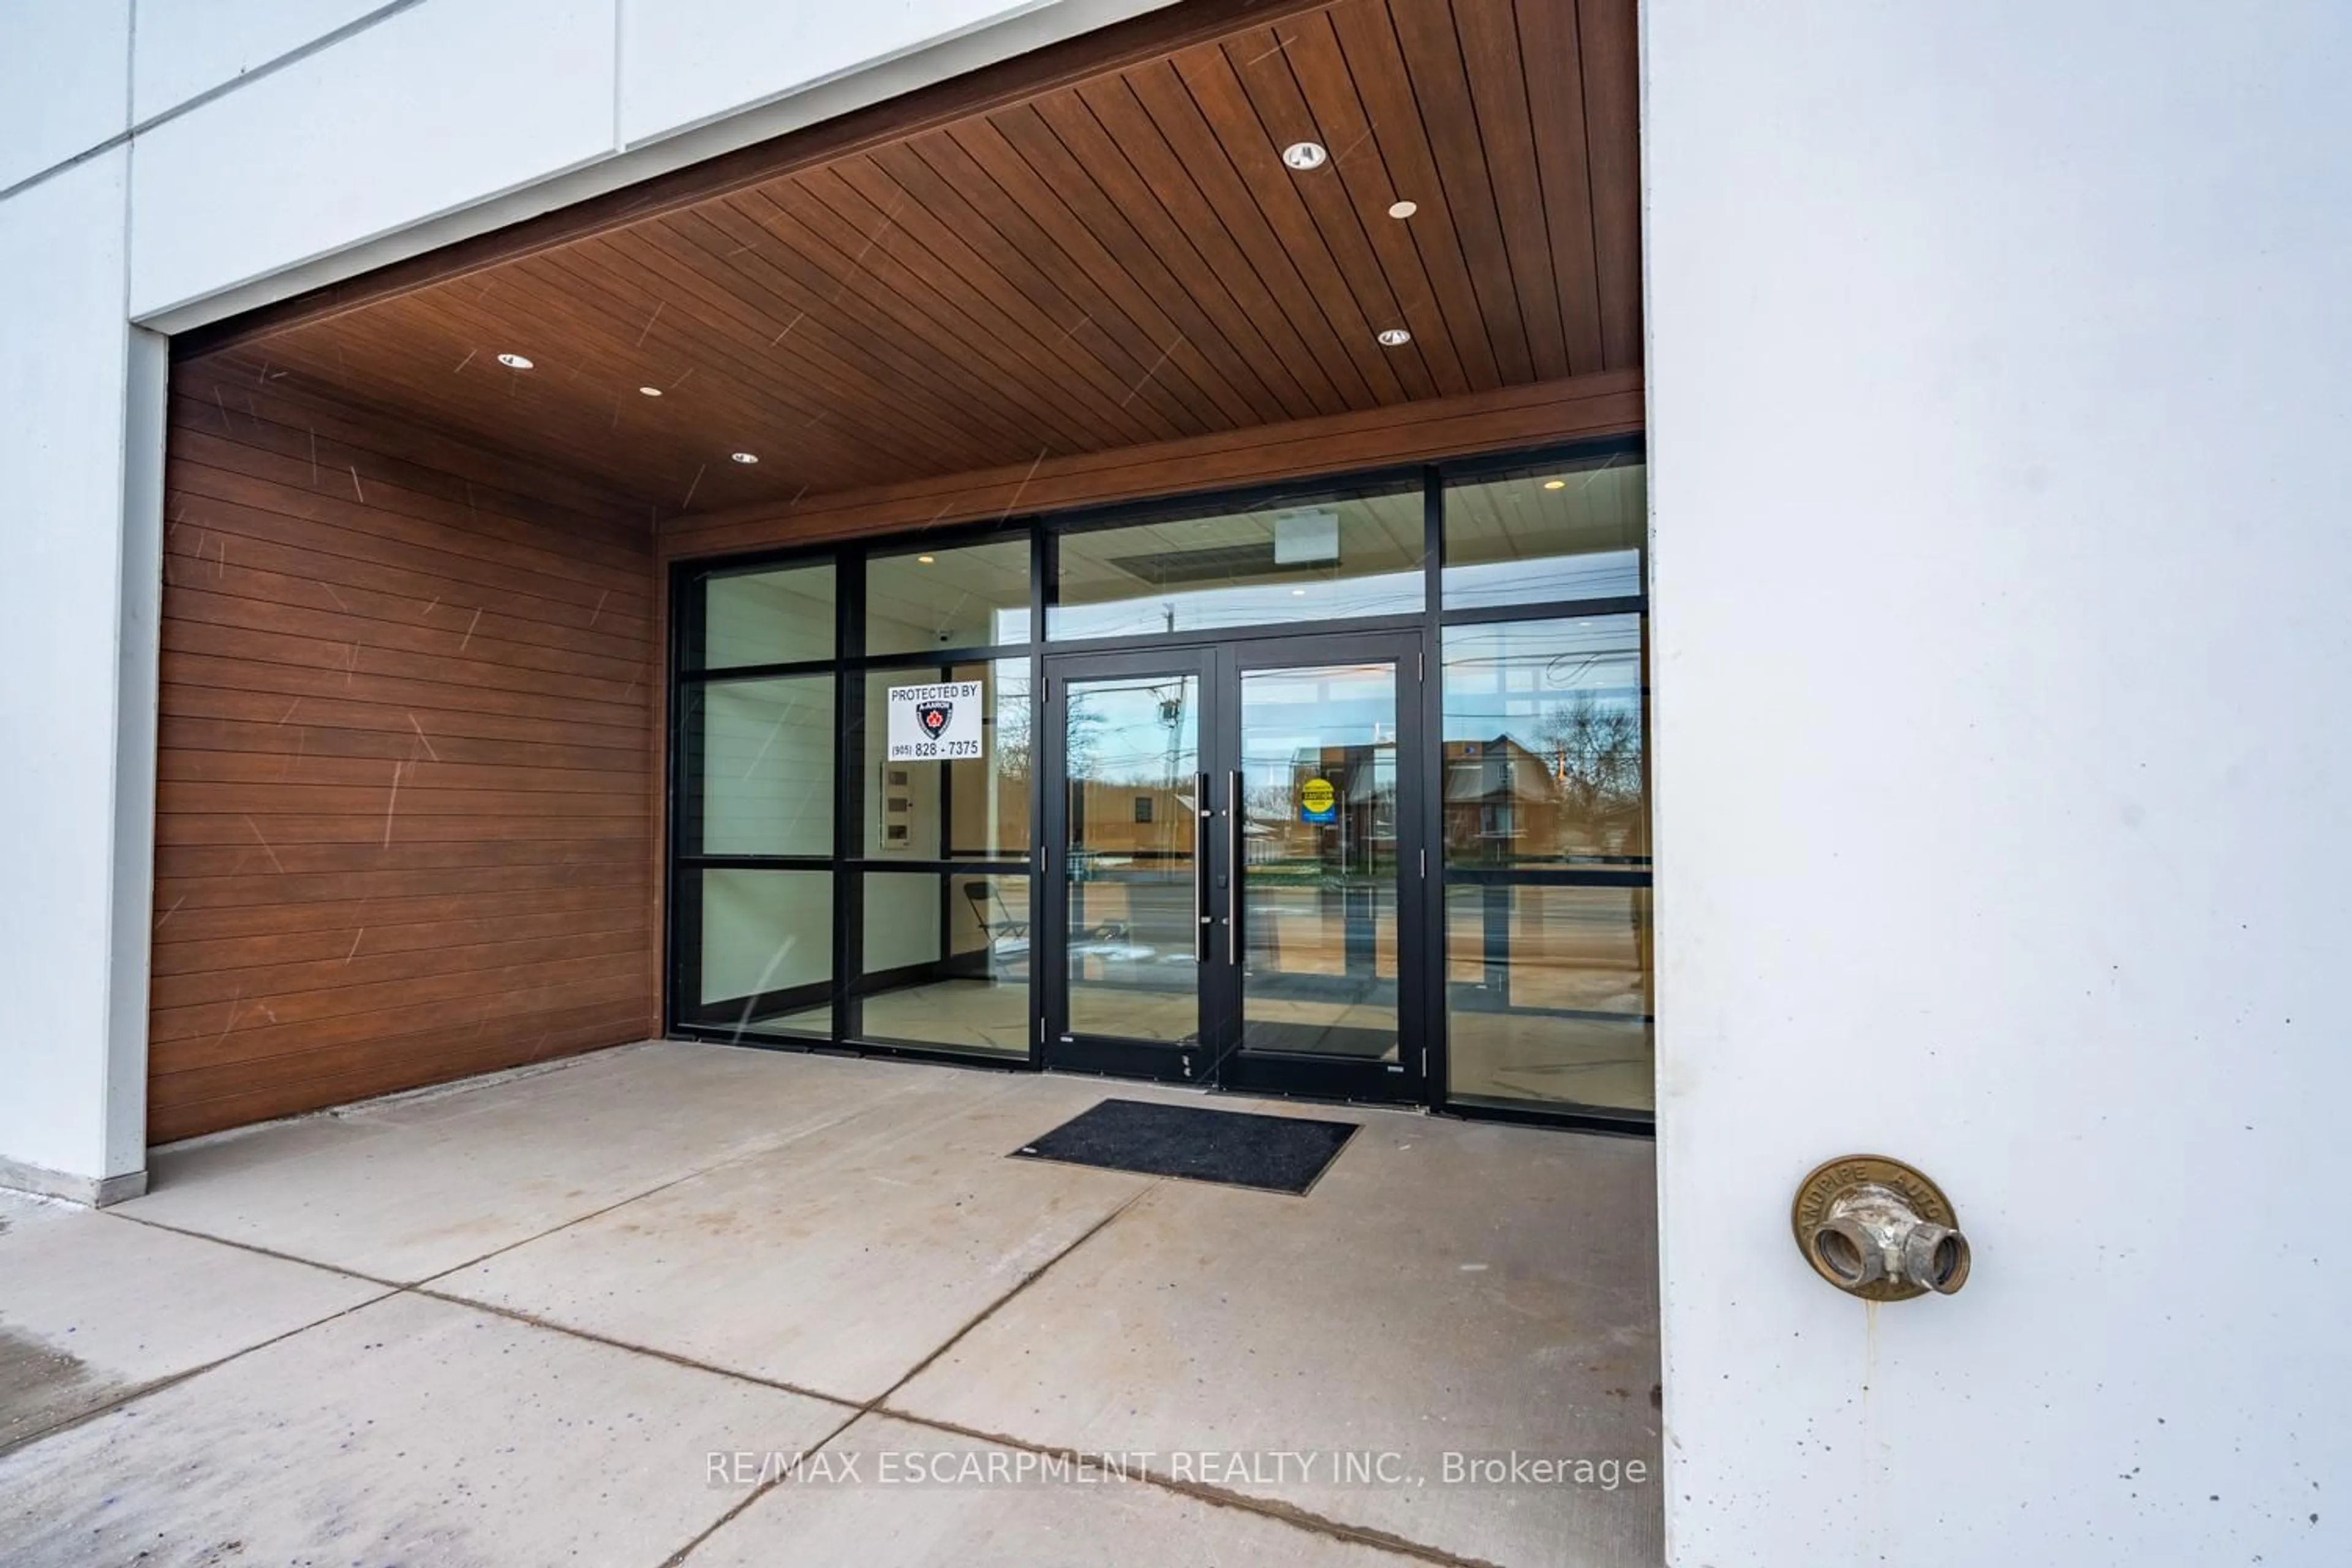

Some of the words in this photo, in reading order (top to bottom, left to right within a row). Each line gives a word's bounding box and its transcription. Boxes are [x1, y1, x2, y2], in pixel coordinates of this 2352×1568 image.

[892, 685, 959, 701] PROTECTED
[962, 684, 978, 697] BY
[892, 745, 913, 756] (905)
[915, 743, 937, 757] 828
[949, 741, 978, 755] 7375
